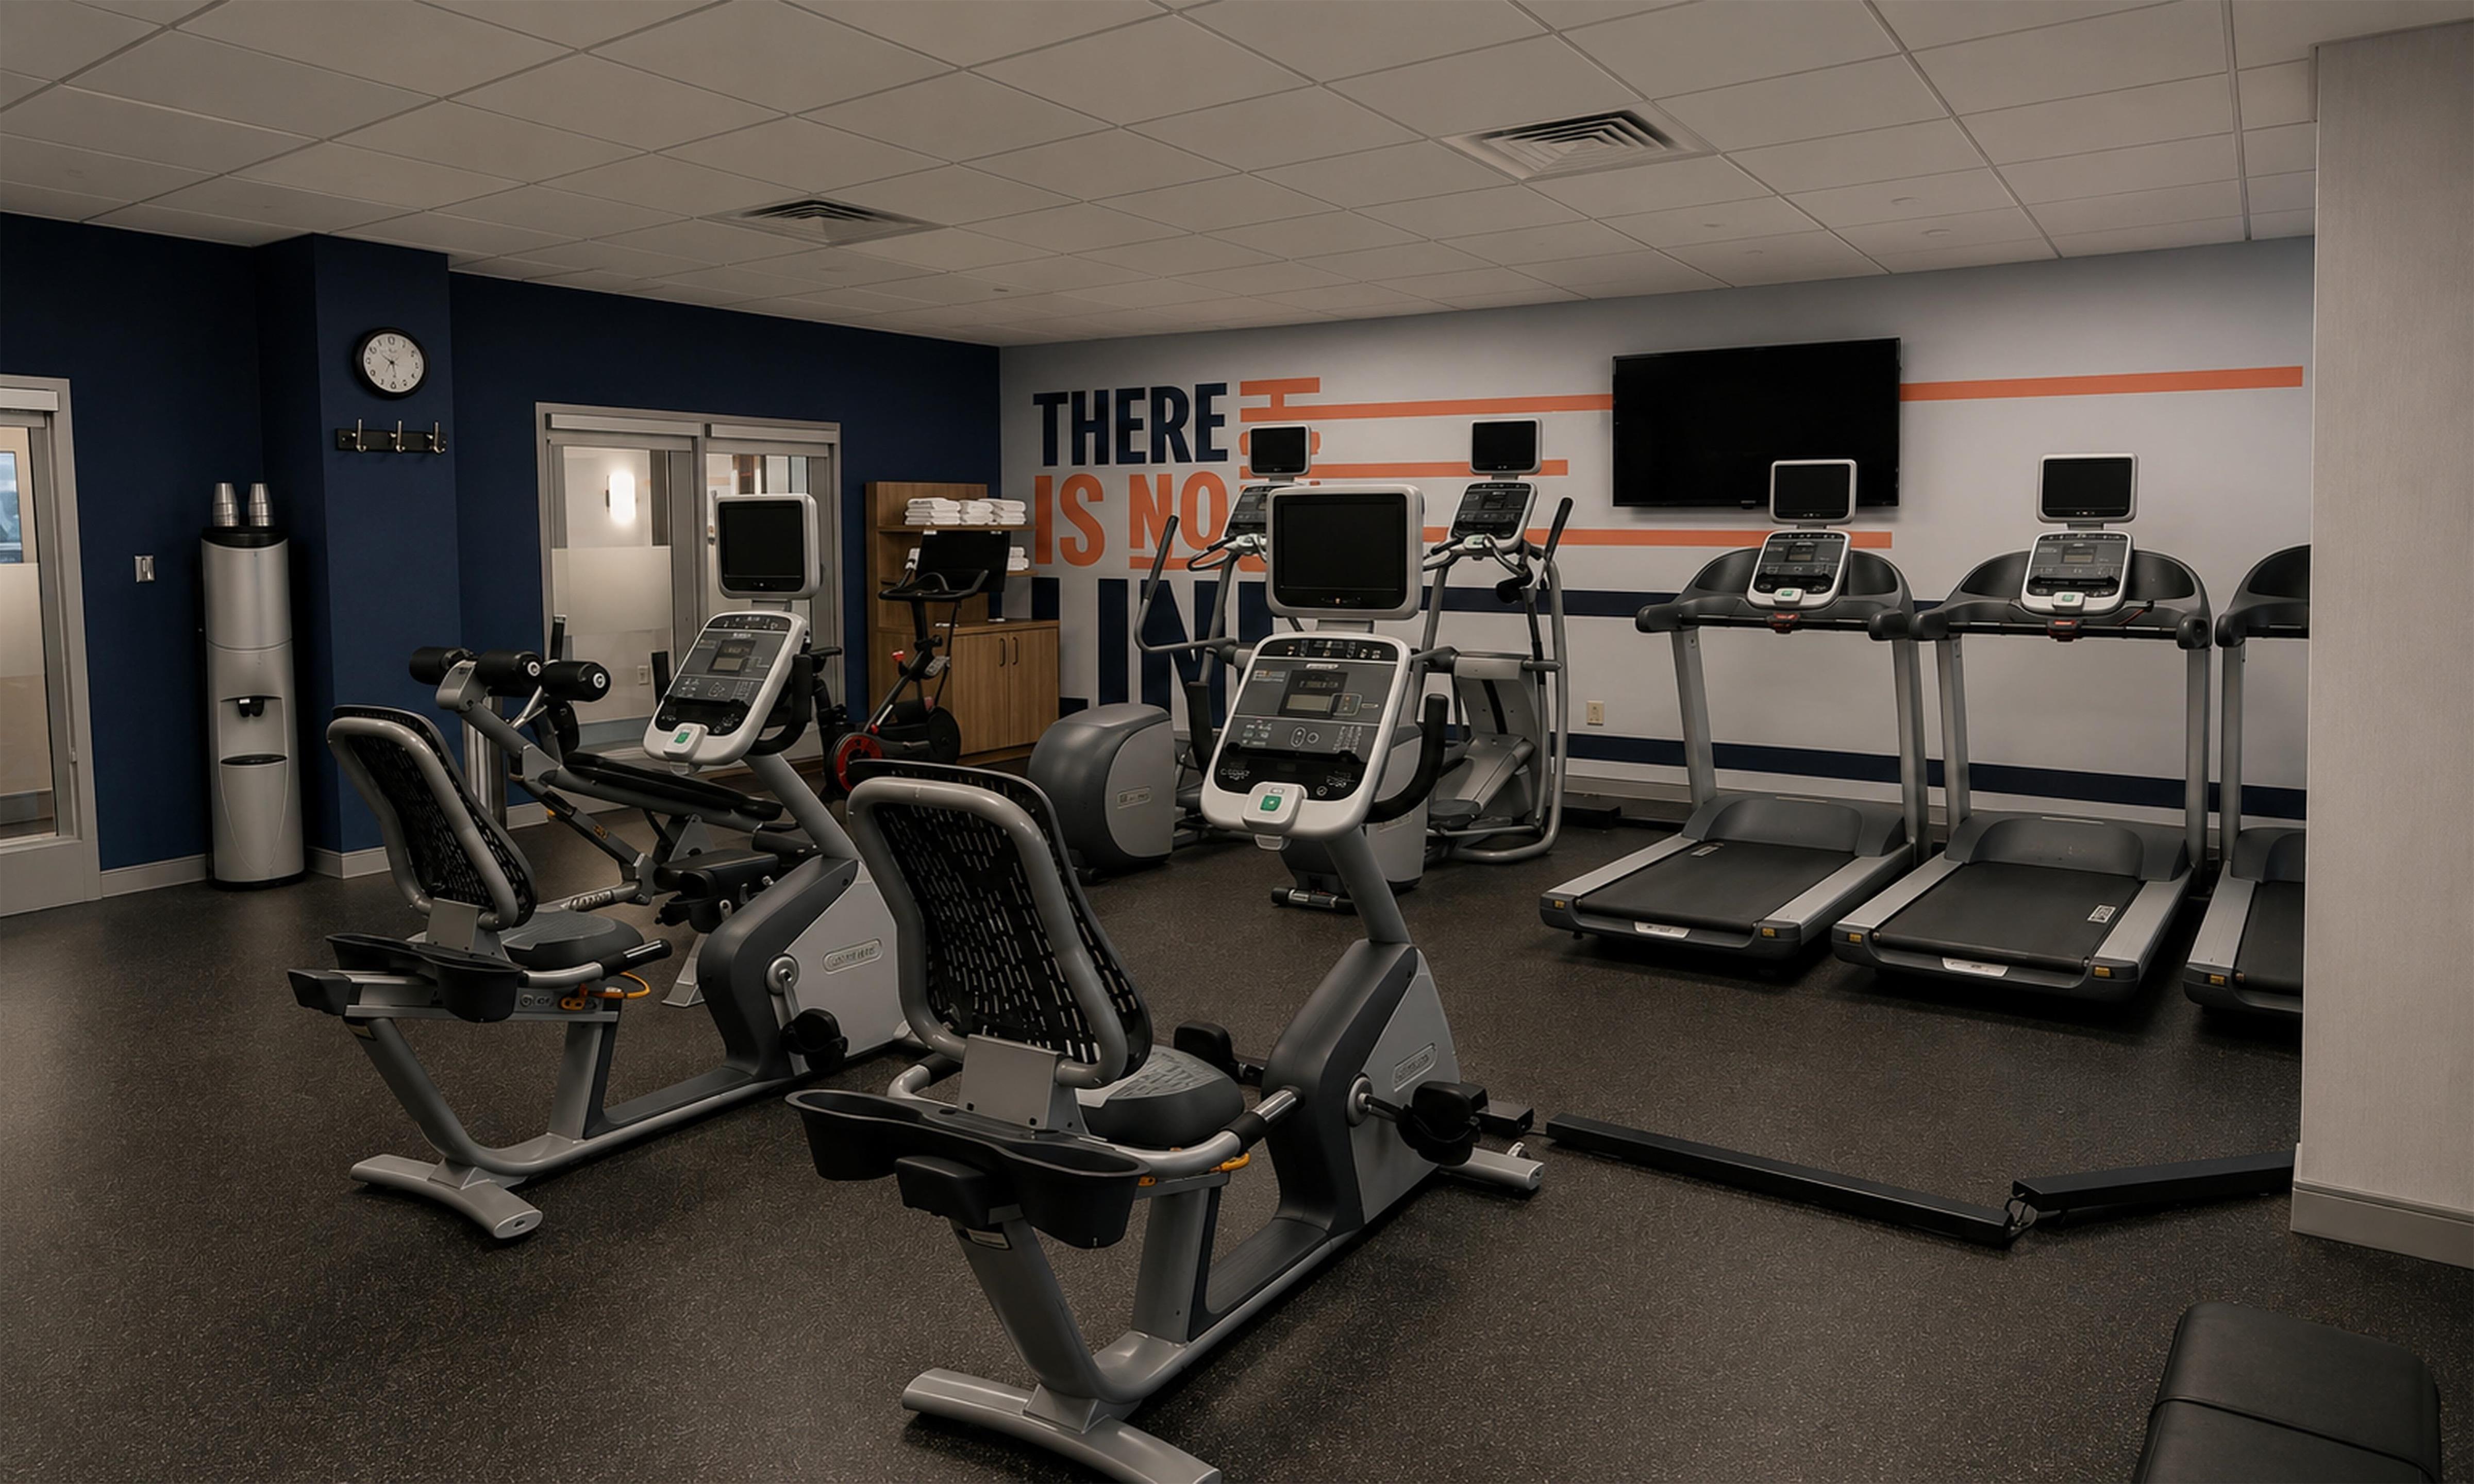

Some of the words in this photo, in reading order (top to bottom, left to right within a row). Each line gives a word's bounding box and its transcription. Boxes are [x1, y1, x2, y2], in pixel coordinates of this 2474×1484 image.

[1032, 383, 1228, 466] THERE
[1035, 470, 1106, 567] IS
[1129, 470, 1229, 551] NO
